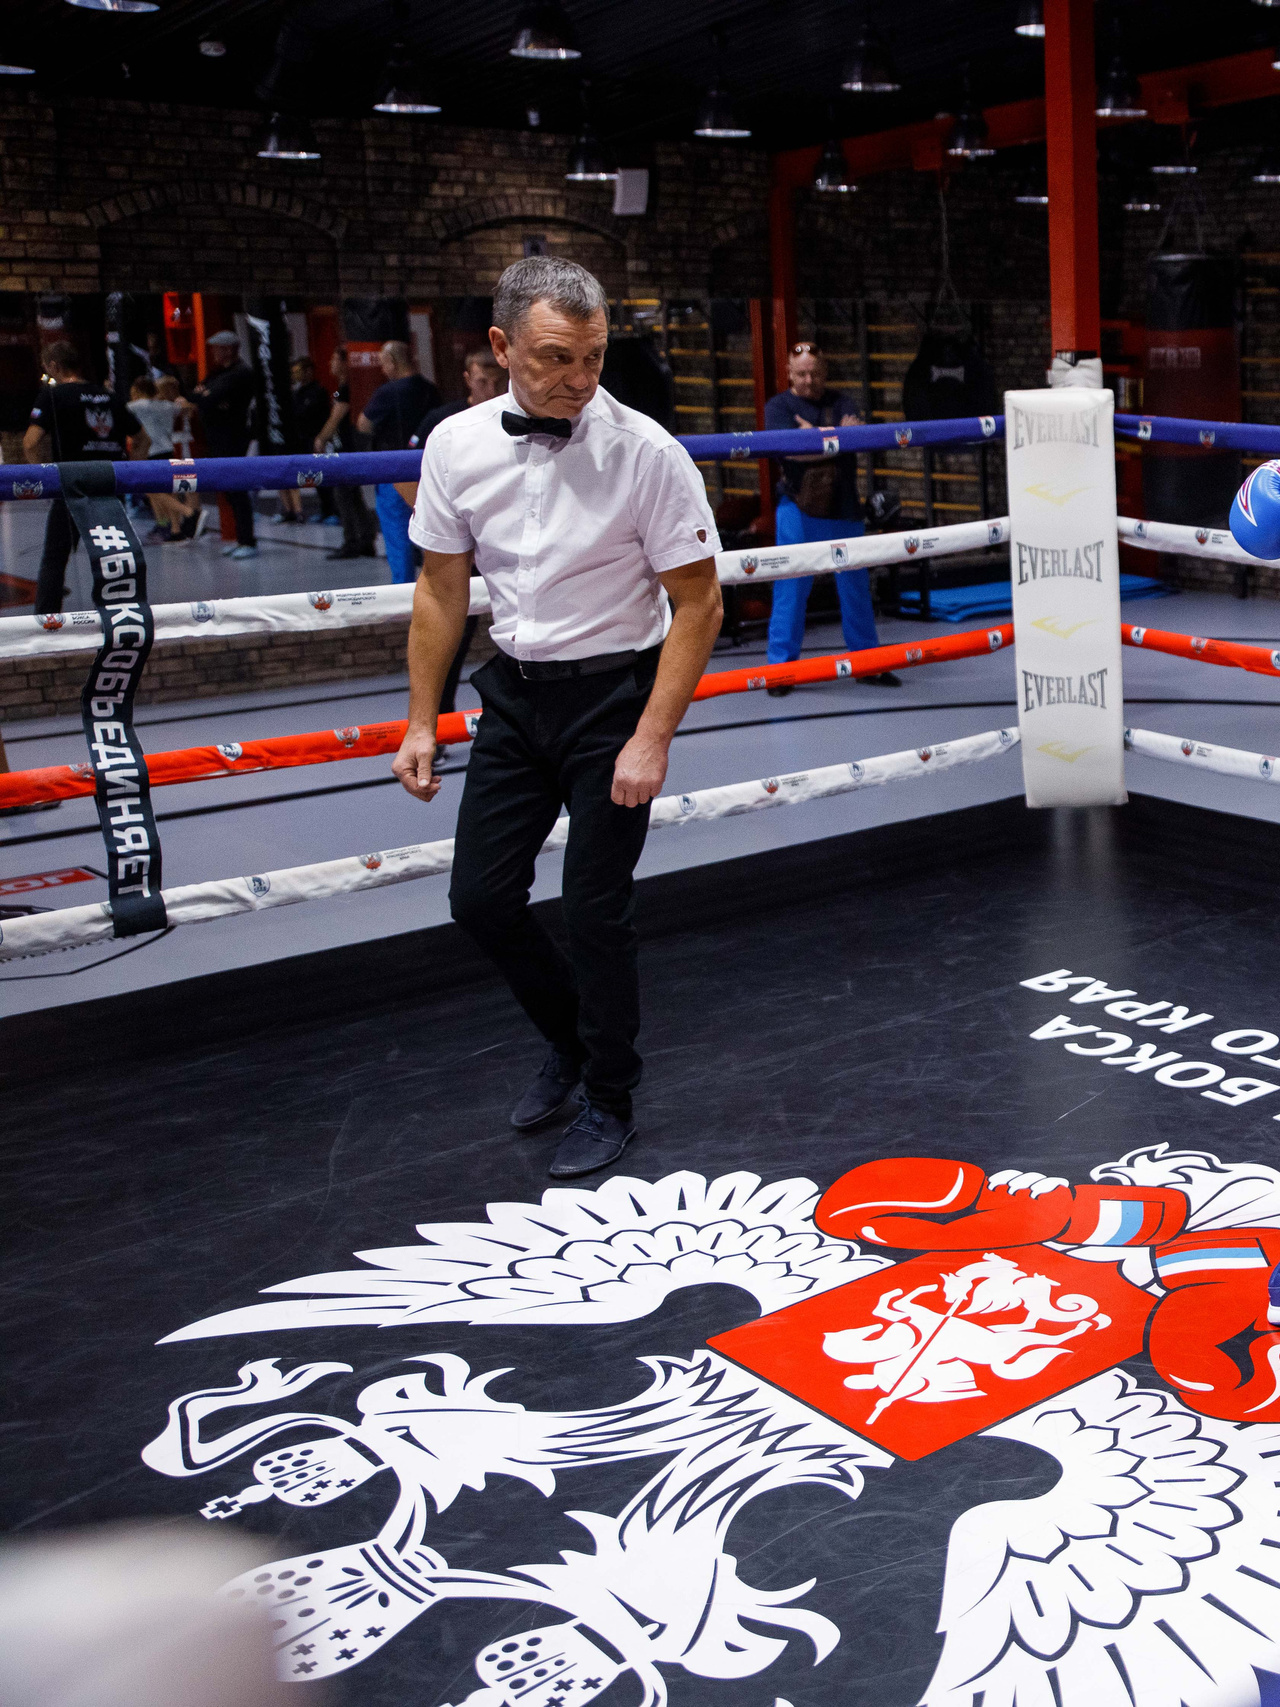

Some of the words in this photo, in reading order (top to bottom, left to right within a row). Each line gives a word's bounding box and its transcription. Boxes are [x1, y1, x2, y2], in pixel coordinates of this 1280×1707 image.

[1013, 405, 1101, 450] EVERLAST
[1016, 540, 1105, 586] EVERLAST
[88, 525, 153, 898] #БОКСОБЪЕДИНЯЕТ
[1022, 668, 1108, 713] EVERLAST
[1019, 968, 1214, 1034] КРАЯ
[1029, 1014, 1280, 1106] БОКСА
